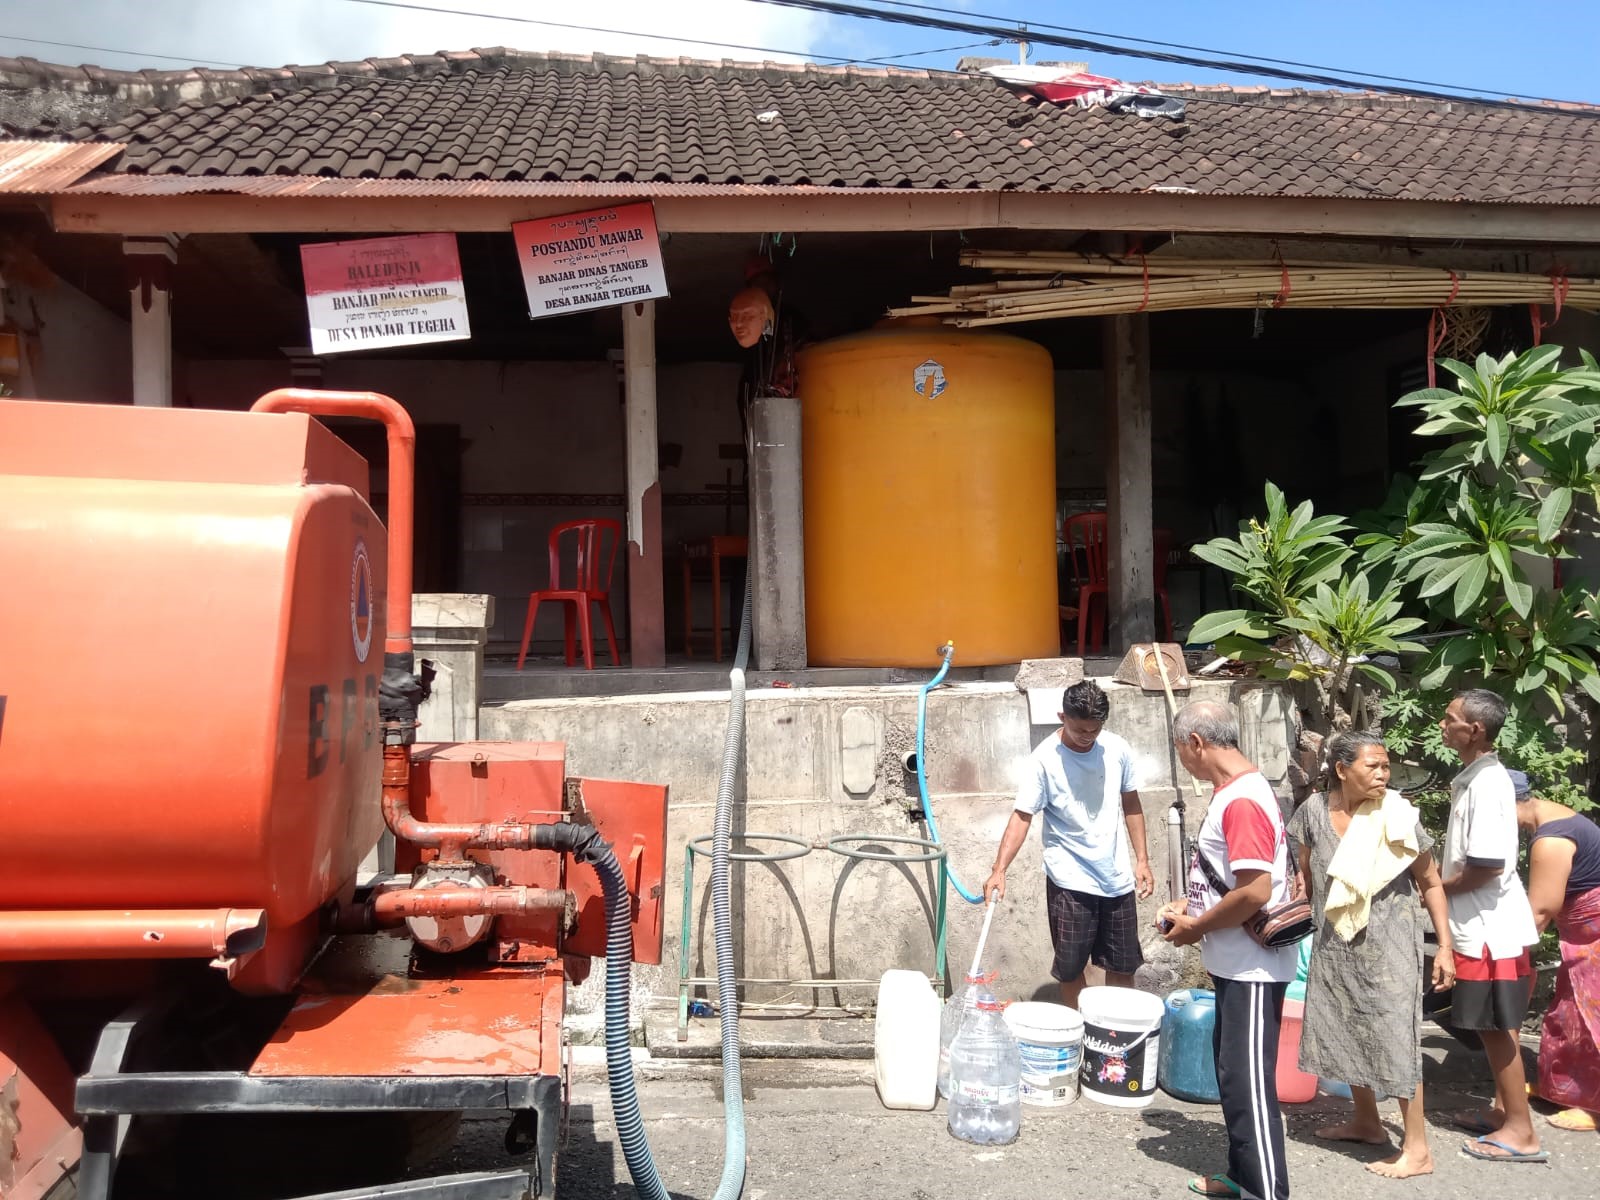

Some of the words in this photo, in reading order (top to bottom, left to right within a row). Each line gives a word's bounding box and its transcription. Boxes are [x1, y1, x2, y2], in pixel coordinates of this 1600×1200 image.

[531, 236, 596, 257] POSYANDU
[599, 228, 644, 246] MAWAR
[538, 271, 575, 285] BANJAR
[578, 265, 608, 278] DINAS
[609, 258, 649, 273] TANGEB
[332, 294, 378, 311] BANJAR
[544, 296, 571, 309] DESA
[573, 291, 610, 305] BANJAR
[611, 284, 652, 299] TEGEHA
[328, 327, 357, 343] DESA
[361, 324, 404, 340] BANJAR
[408, 317, 456, 335] TEGEHA
